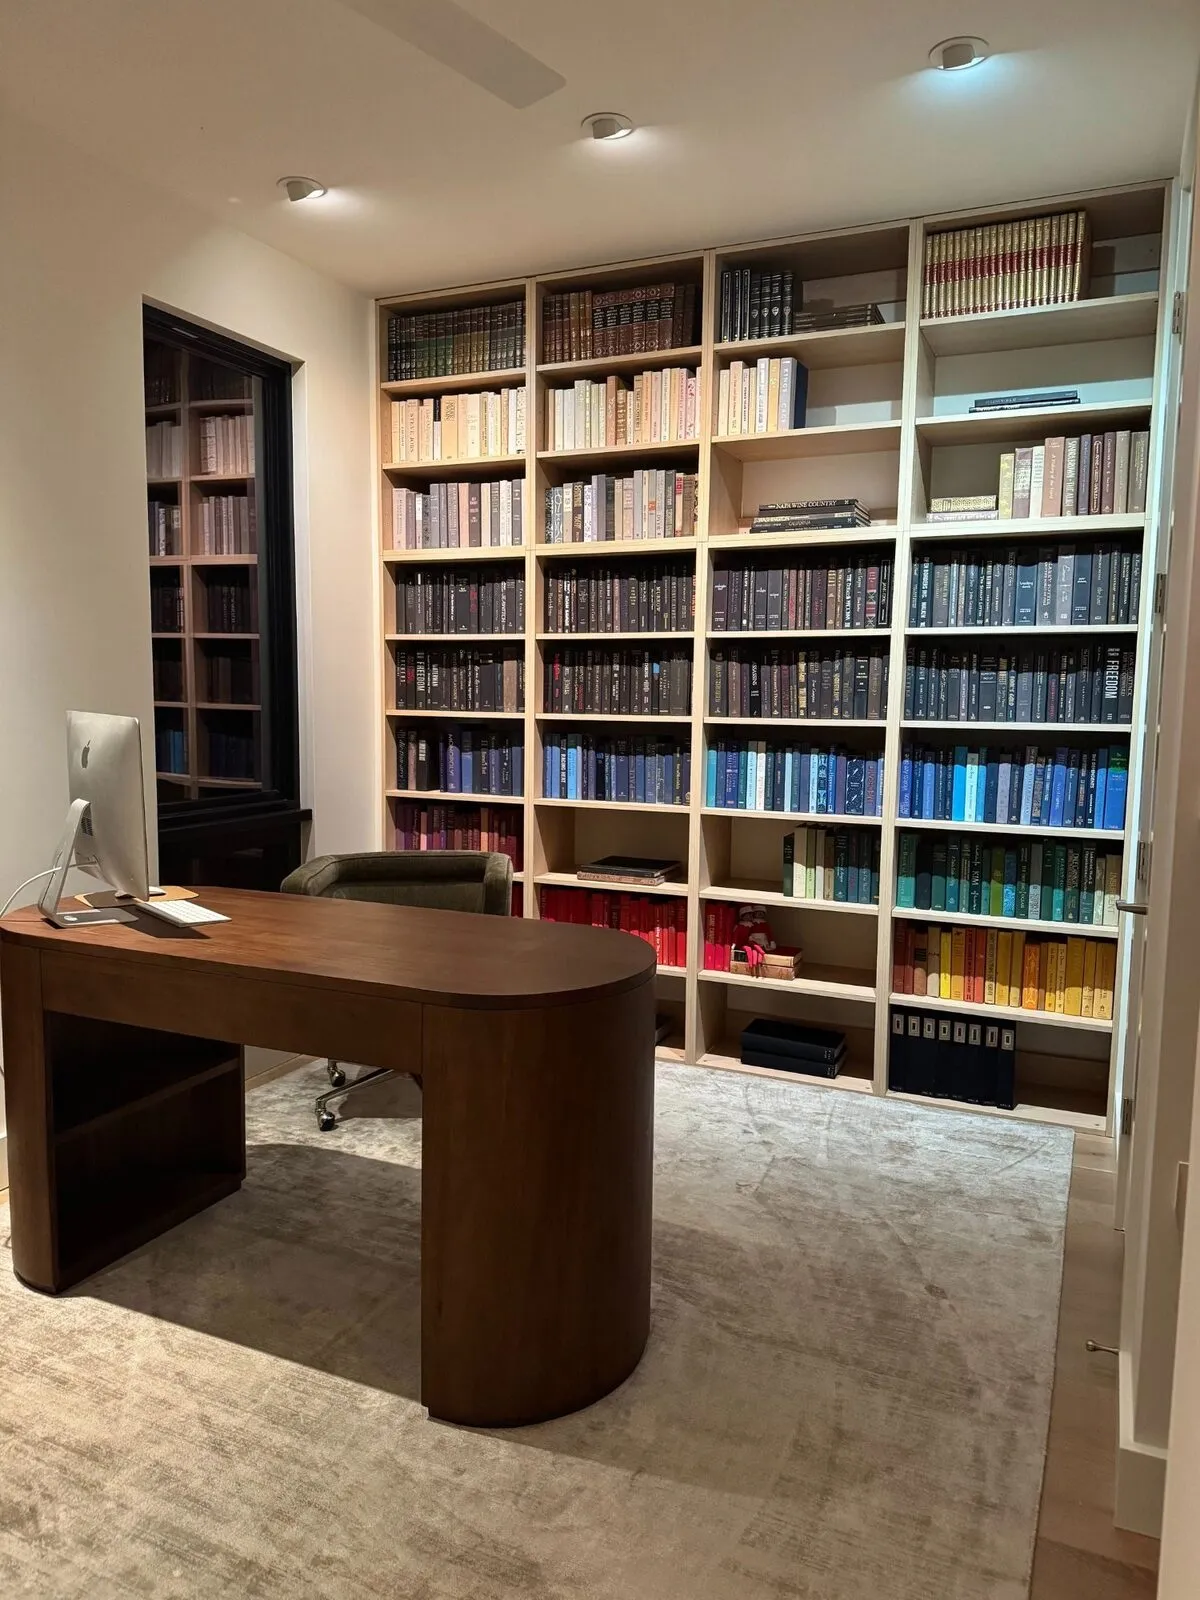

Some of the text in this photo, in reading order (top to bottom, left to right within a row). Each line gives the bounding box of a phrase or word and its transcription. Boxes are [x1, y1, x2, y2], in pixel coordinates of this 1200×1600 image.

[409, 413, 417, 454] STEVE JOBS
[808, 499, 837, 508] COUNTRY
[416, 661, 425, 692] FREEDOM
[1104, 660, 1120, 699] FREEDOM
[971, 870, 980, 886] KIM
[1107, 872, 1118, 914] INSURGENT
